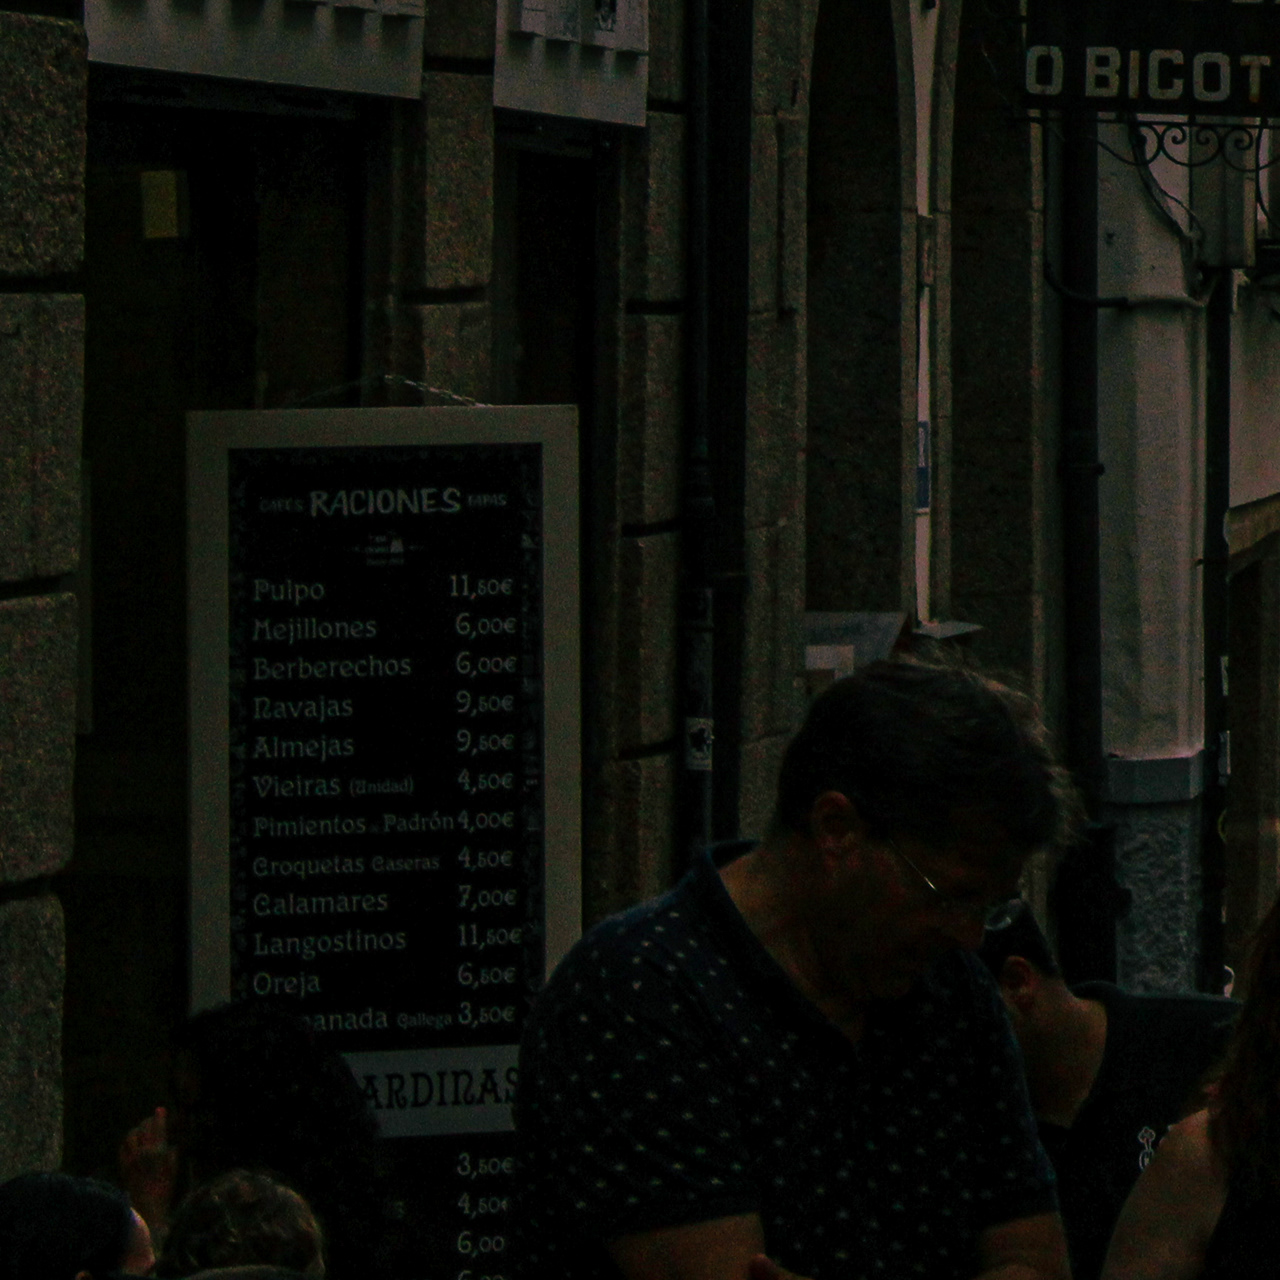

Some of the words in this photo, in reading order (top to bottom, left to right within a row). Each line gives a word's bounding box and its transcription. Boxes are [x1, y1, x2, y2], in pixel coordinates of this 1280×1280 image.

[1025, 45, 1064, 96] O
[309, 487, 462, 518] RACIONES
[252, 577, 326, 607] Pulpo
[251, 617, 378, 647] Mejillones
[455, 611, 518, 640] 6,00€
[252, 654, 414, 681] Berberechos
[455, 650, 518, 678] 6,00€
[252, 694, 354, 724] Navajas
[251, 733, 356, 764] Almejas
[251, 773, 343, 799] Vieiras
[251, 814, 369, 838] Pimientos
[382, 810, 454, 833] Padrón
[456, 808, 515, 834] 4,00€
[251, 854, 365, 880] Croquetas
[371, 854, 441, 872] Caseras
[252, 891, 390, 916] Calamares
[457, 884, 519, 912] 7,00€
[252, 928, 409, 961] Langostinos
[252, 971, 322, 1000] Oreja
